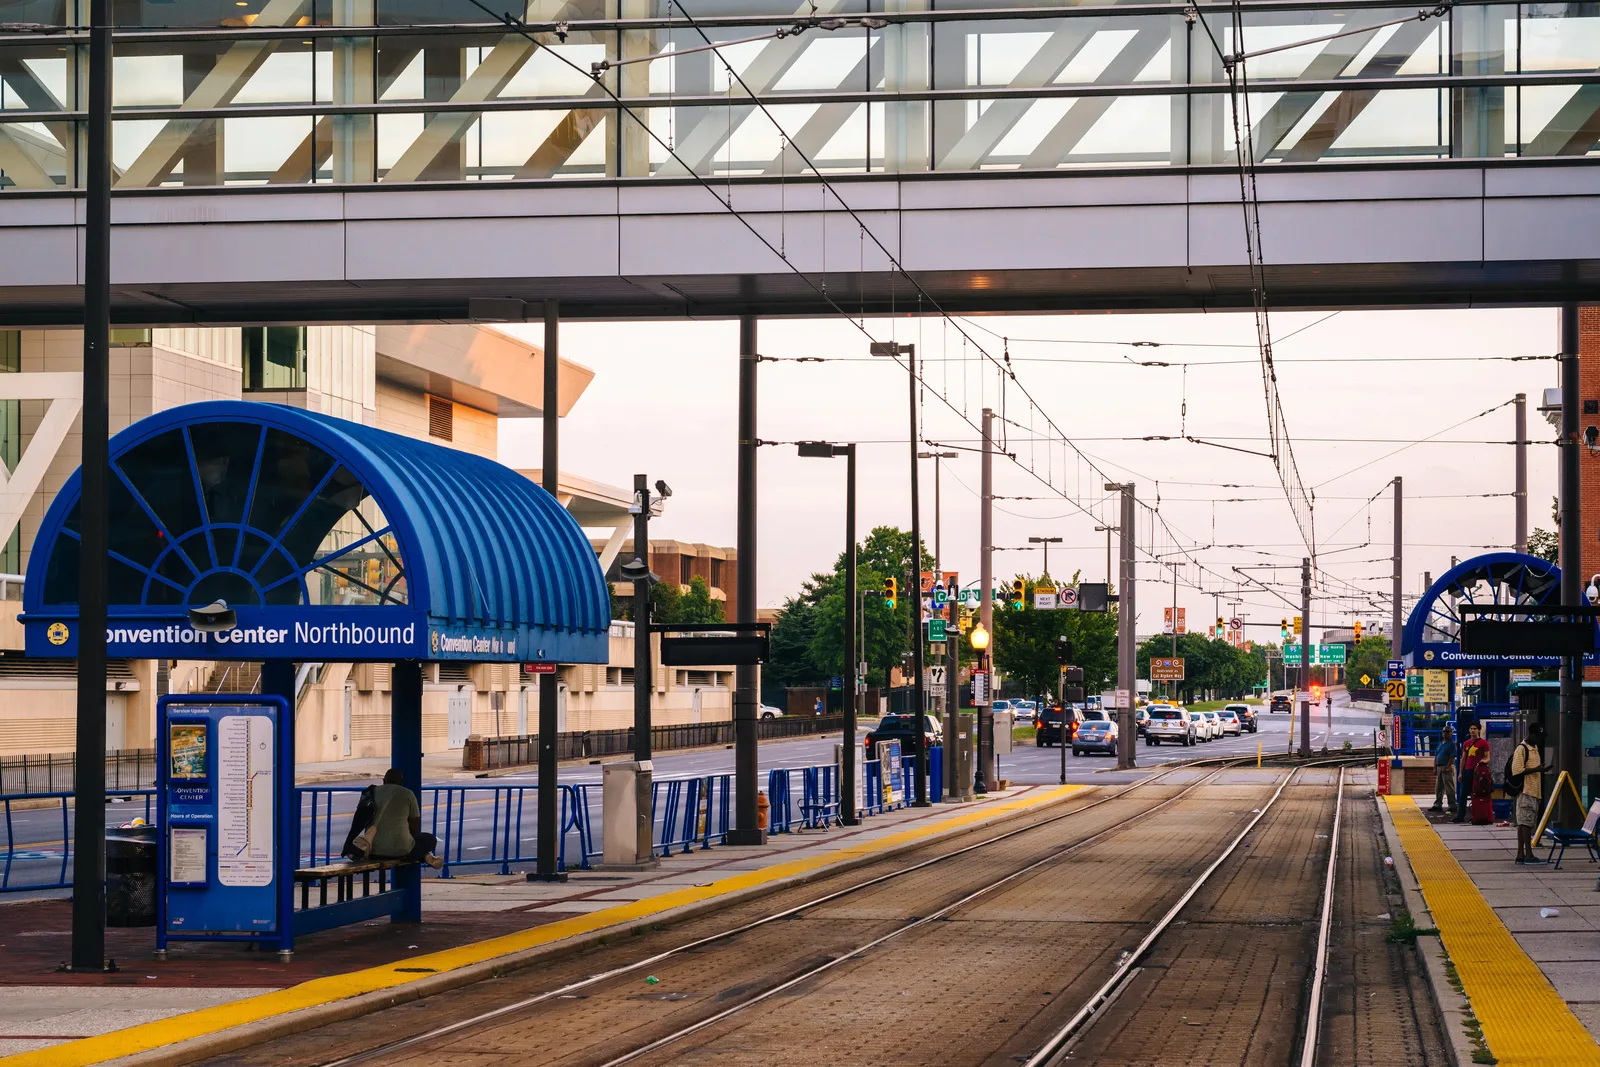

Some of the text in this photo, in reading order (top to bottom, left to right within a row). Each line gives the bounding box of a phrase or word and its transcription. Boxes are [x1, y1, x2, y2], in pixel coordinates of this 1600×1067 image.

[106, 622, 415, 644] onvention Center Northbound
[440, 633, 472, 652] Convention
[472, 635, 490, 653] Center
[1388, 682, 1405, 698] 20
